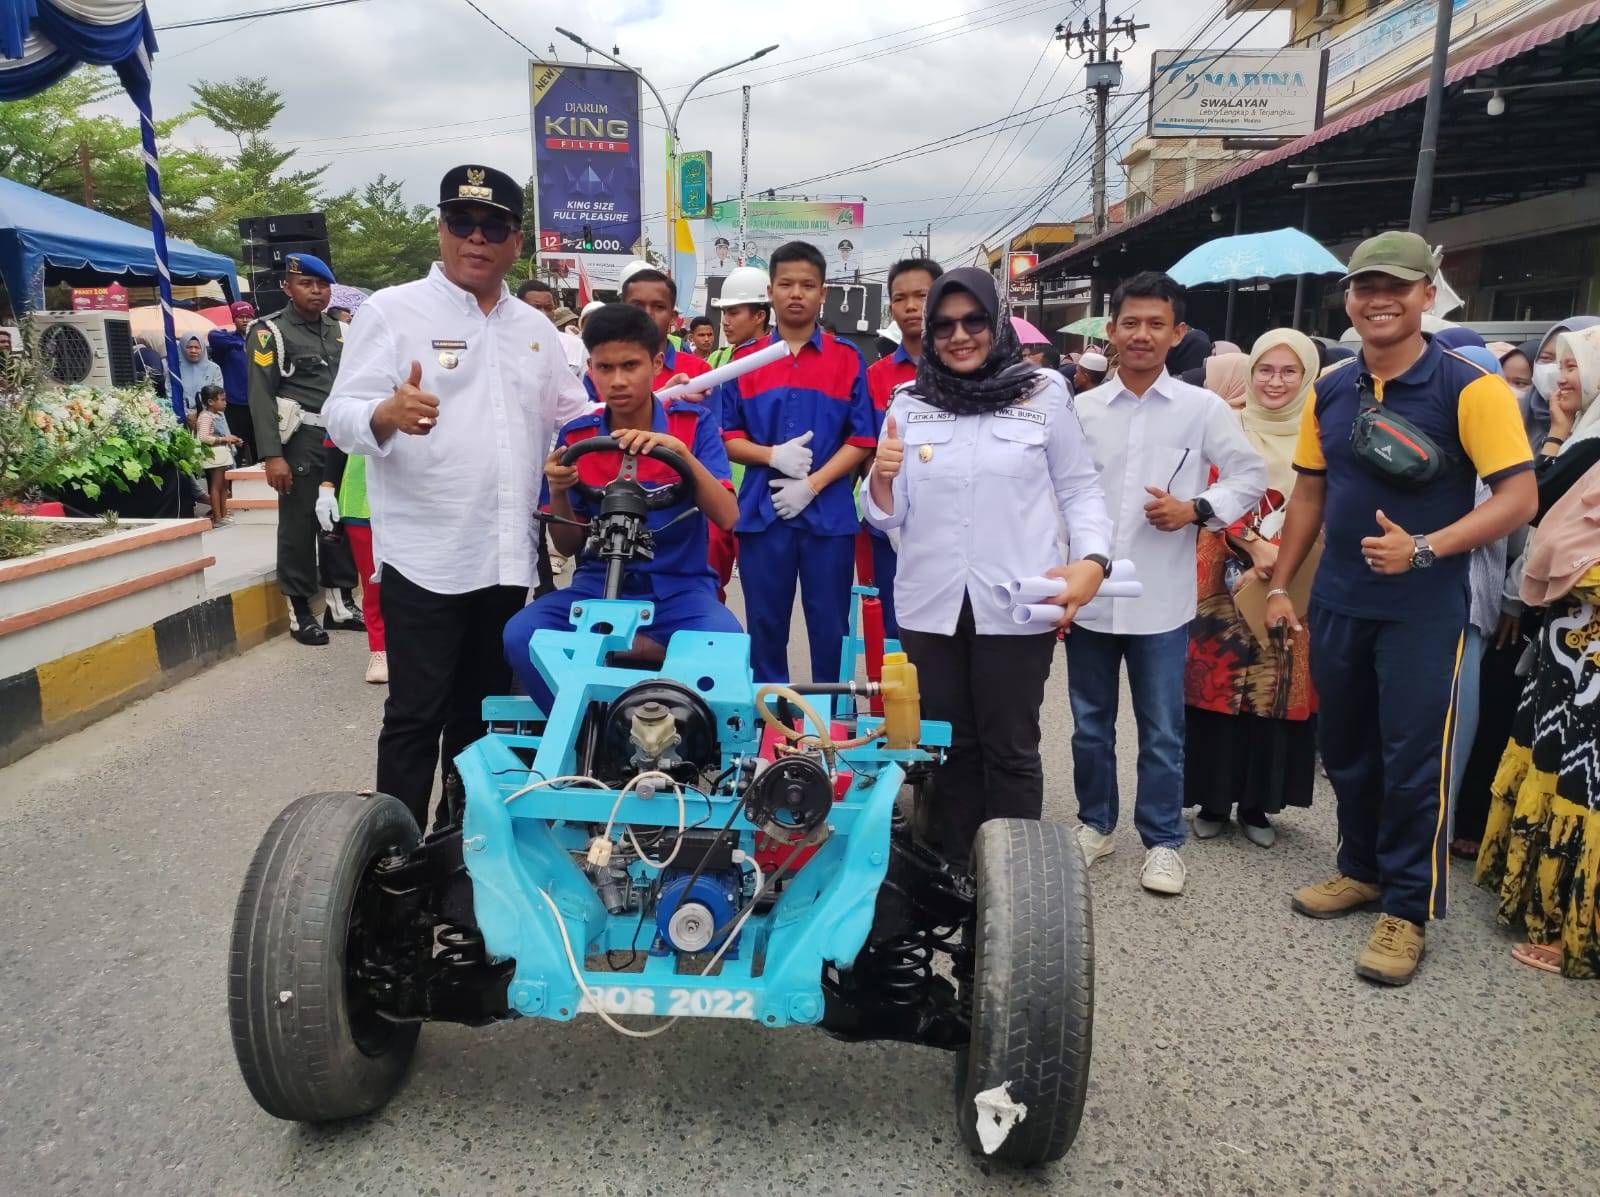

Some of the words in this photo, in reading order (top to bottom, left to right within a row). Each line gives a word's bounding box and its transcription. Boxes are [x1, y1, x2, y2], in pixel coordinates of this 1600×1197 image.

[535, 67, 556, 91] NEW
[565, 102, 608, 114] DJARUM
[1200, 98, 1268, 108] SWALAYAN
[544, 115, 629, 139] KING
[560, 141, 615, 150] FILTER
[567, 201, 591, 210] KING
[593, 202, 615, 211] SIZE
[553, 211, 577, 220] FULL
[579, 212, 629, 222] PLEASURE
[544, 236, 557, 247] 12
[998, 408, 1014, 417] WKL
[1017, 410, 1043, 422] BUPATI
[669, 988, 754, 1018] 2022
